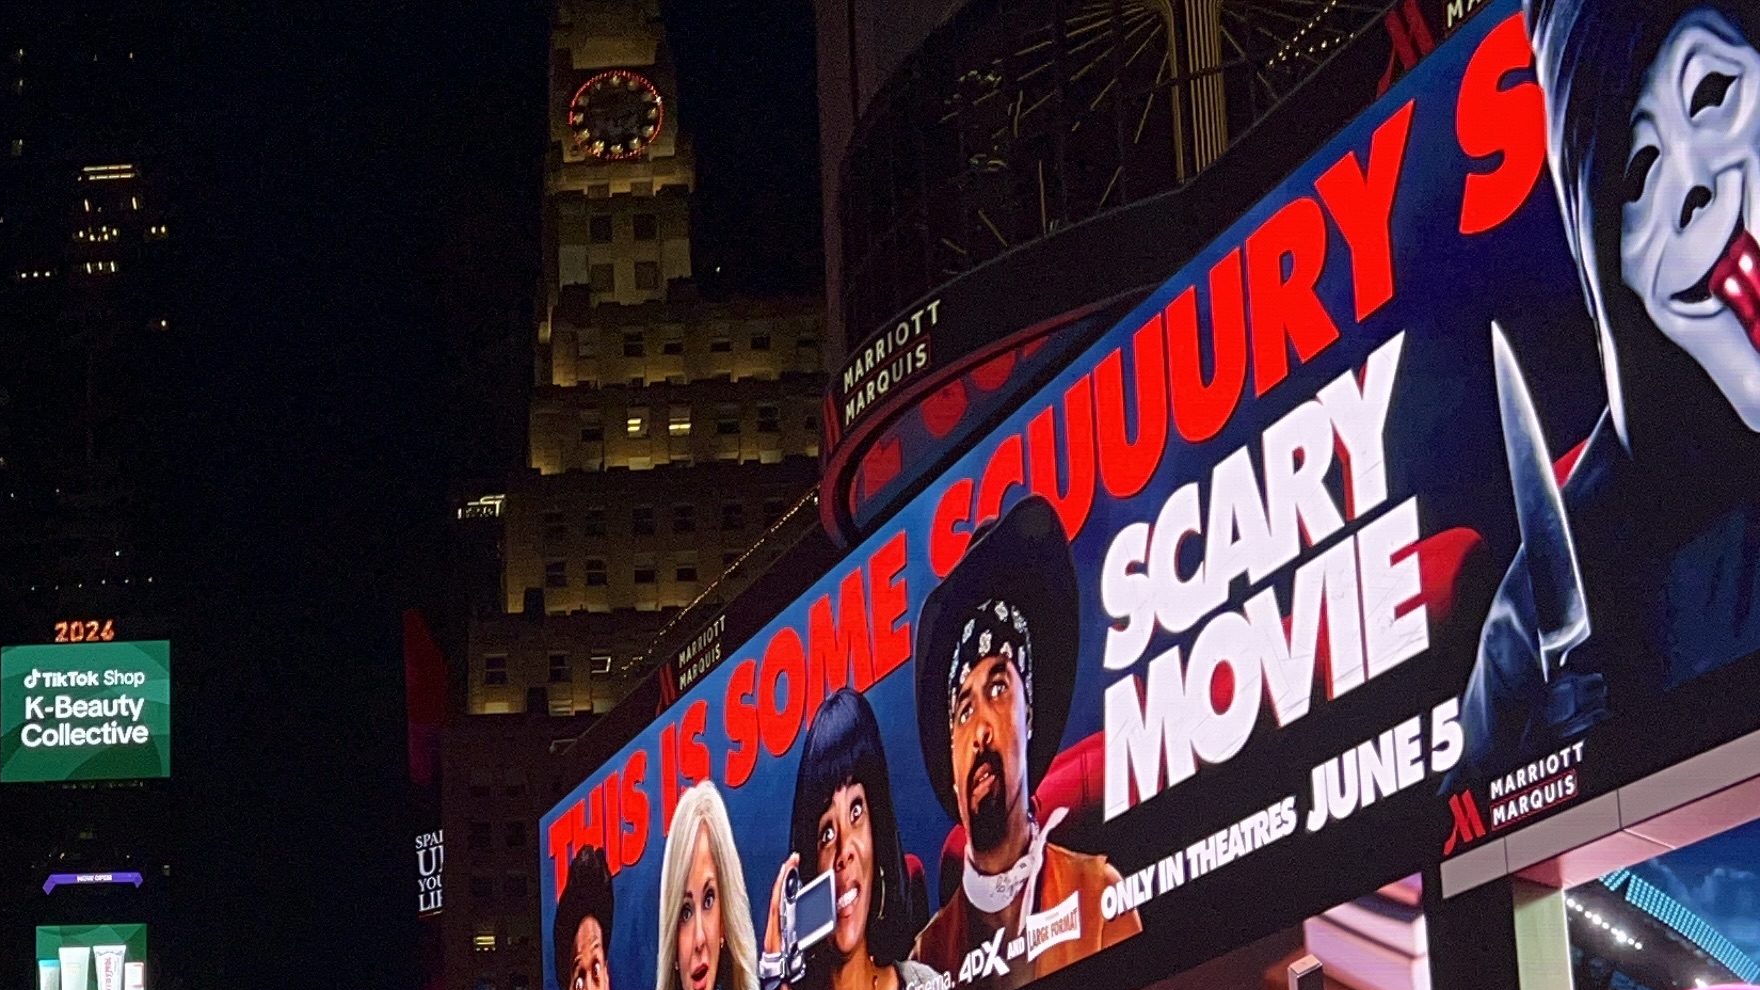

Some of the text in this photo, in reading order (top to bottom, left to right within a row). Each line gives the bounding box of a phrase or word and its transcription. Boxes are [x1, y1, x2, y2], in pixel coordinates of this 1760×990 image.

[843, 299, 941, 394] MARRIOTT
[845, 343, 927, 426] MARQUIS
[1101, 329, 1406, 671] SCARY
[54, 619, 115, 642] 2026
[679, 614, 726, 668] MARRIOTT
[1103, 496, 1430, 823] MOVIE
[42, 669, 145, 687] TikTok Shop
[680, 643, 721, 690] MARQUIS
[21, 721, 149, 747] Collective
[25, 694, 144, 721] K-Beauty
[548, 750, 650, 905] THIS
[660, 700, 710, 837] IS
[724, 528, 912, 788] SOME
[1490, 740, 1584, 799] MARRIOTT
[1101, 697, 1464, 919] ONLY IN THEATRES JUNE 5
[1492, 775, 1577, 827] MARQUIS
[959, 927, 1010, 983] 4DX
[1007, 937, 1025, 960] AND
[1028, 926, 1049, 949] LARGE
[1050, 907, 1078, 938] FORMAT
